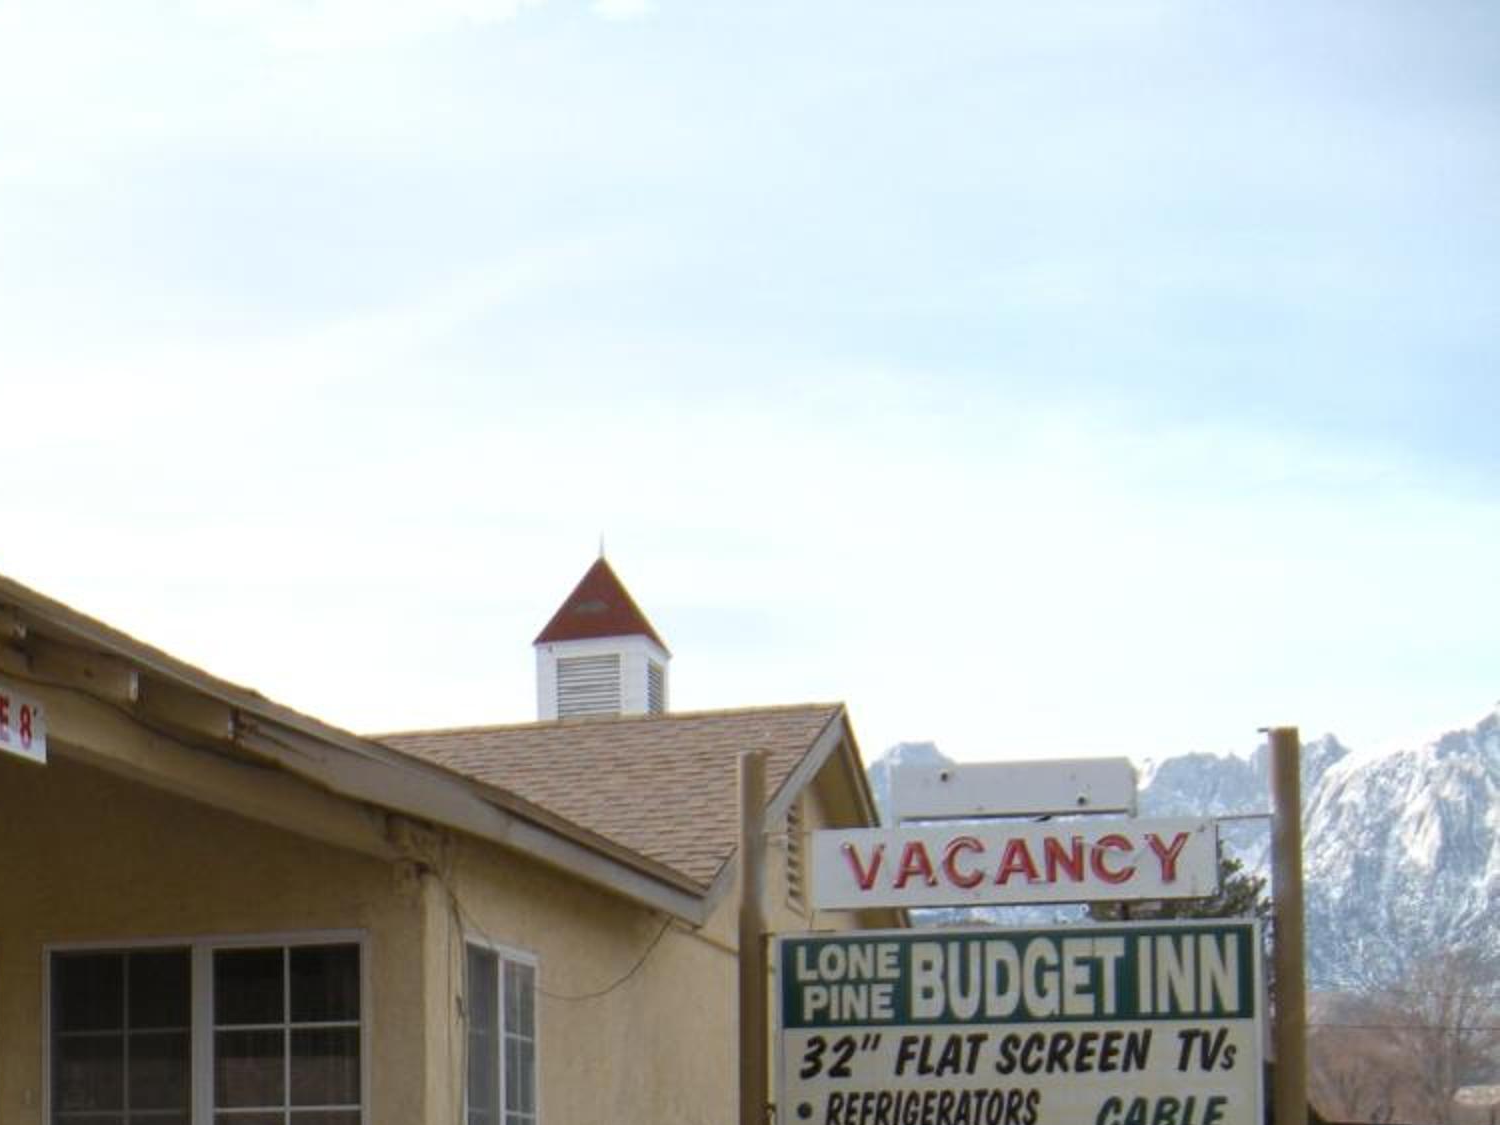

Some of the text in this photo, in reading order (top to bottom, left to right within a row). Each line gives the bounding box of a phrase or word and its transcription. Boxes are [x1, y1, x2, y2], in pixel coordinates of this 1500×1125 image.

[842, 832, 1190, 891] VACANCY
[797, 943, 900, 982] LONE
[910, 932, 1239, 1020] BUDGET INN
[802, 984, 896, 1022] PINE
[800, 1028, 1237, 1079] 32" FLAT SCREEN TVs
